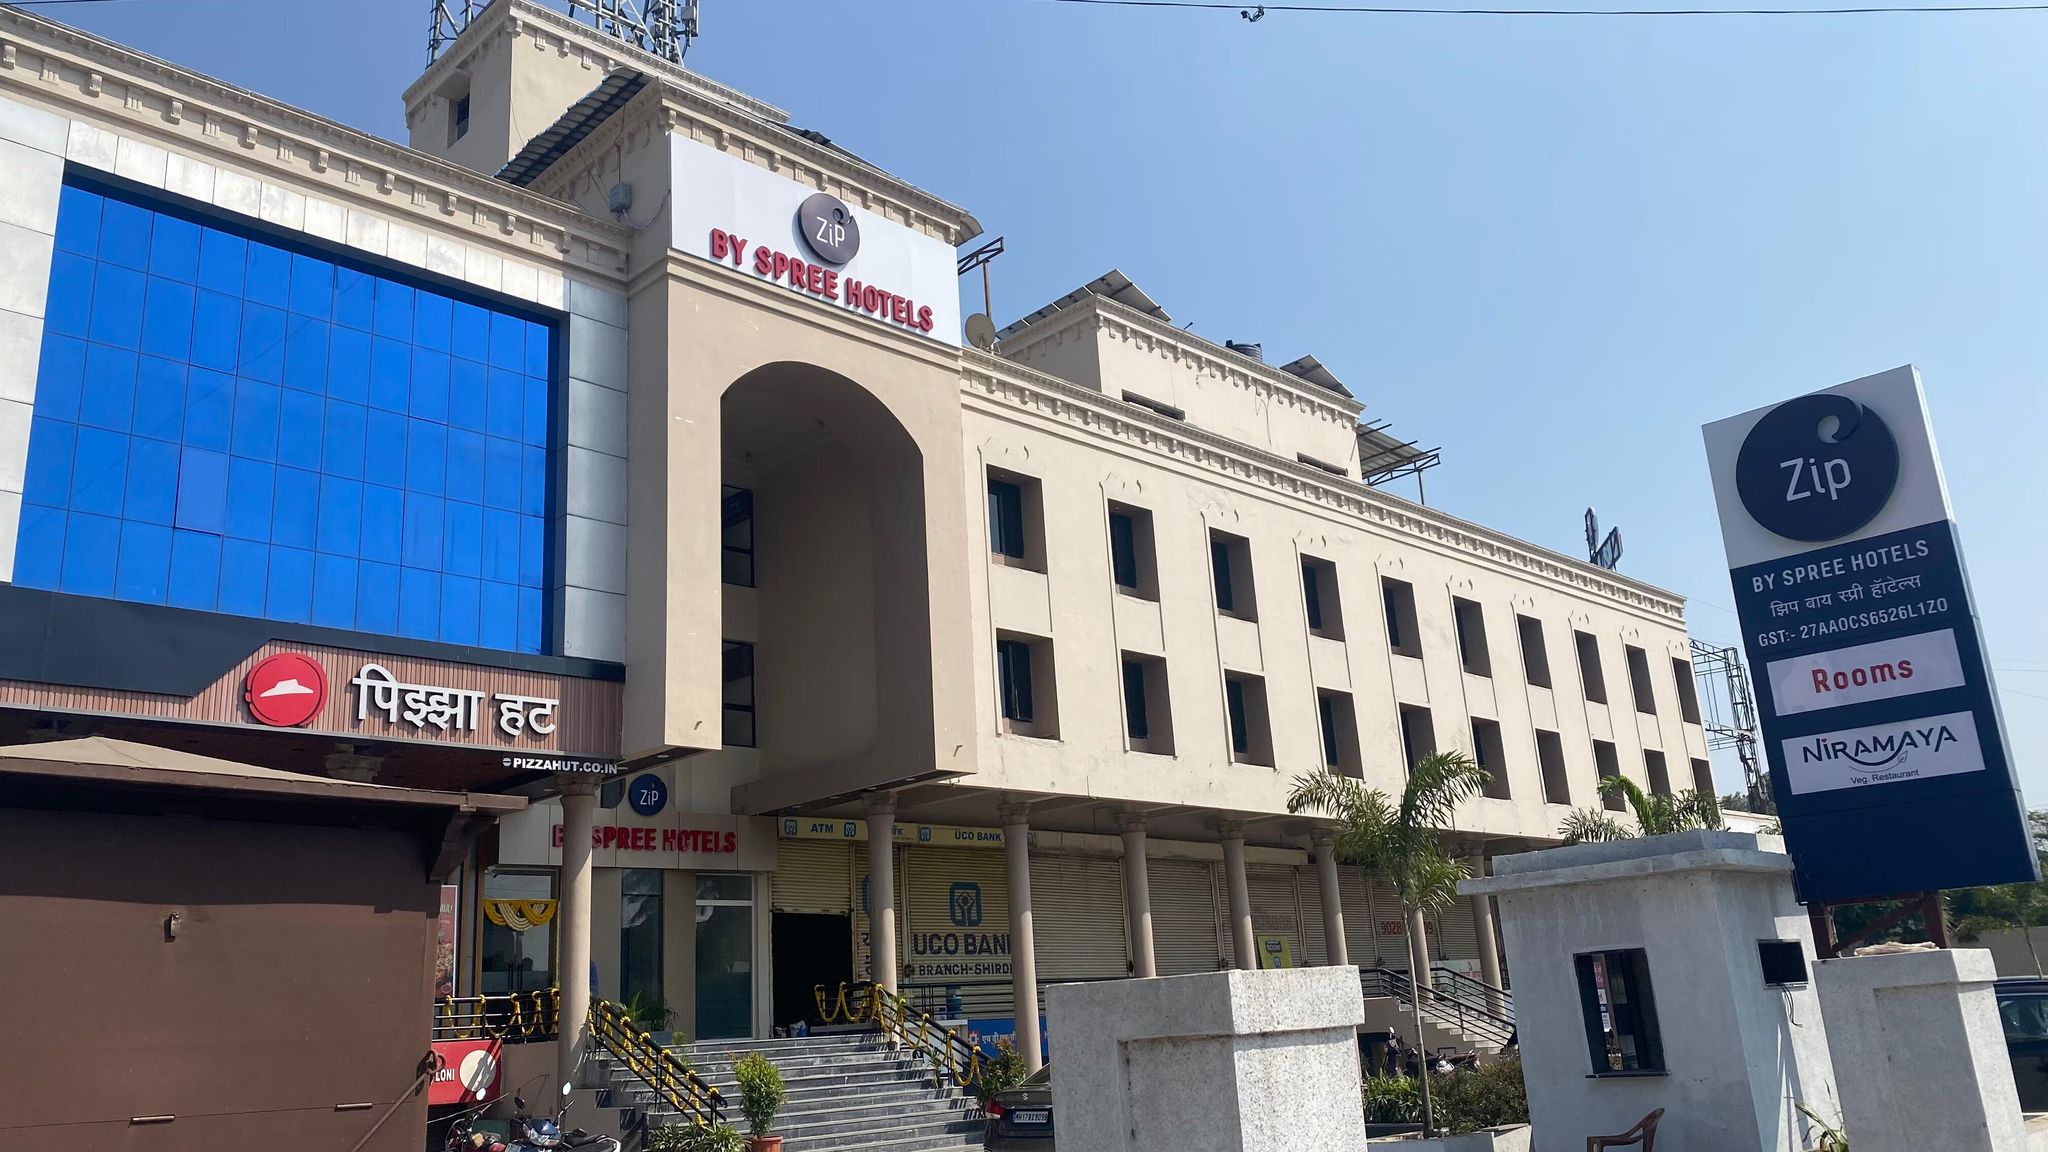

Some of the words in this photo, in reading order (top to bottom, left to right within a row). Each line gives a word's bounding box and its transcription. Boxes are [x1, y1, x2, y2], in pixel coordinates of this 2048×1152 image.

[710, 228, 748, 265] BY
[753, 245, 839, 300] SPREE
[846, 277, 934, 332] HOTELS
[1780, 456, 1851, 502] Zip
[1752, 573, 1775, 593] BY
[1783, 558, 1846, 587] SPREE
[1851, 539, 1929, 572] HOTELS
[1770, 600, 1800, 617] झिप
[1804, 593, 1832, 609] बाय
[1837, 583, 1864, 602] स्प्री
[1811, 659, 1914, 693] Rooms
[495, 692, 560, 736] हट
[512, 756, 618, 774] PIZZAHUT.CO.IN
[1851, 776, 1869, 785] Veg.
[1872, 769, 1919, 782] Restaurant
[592, 825, 657, 851] SPREE
[662, 828, 737, 854] HOTELS
[811, 823, 834, 834] ATM
[954, 831, 975, 841] UCO
[977, 831, 1002, 842] BANK
[912, 933, 959, 956] UCO
